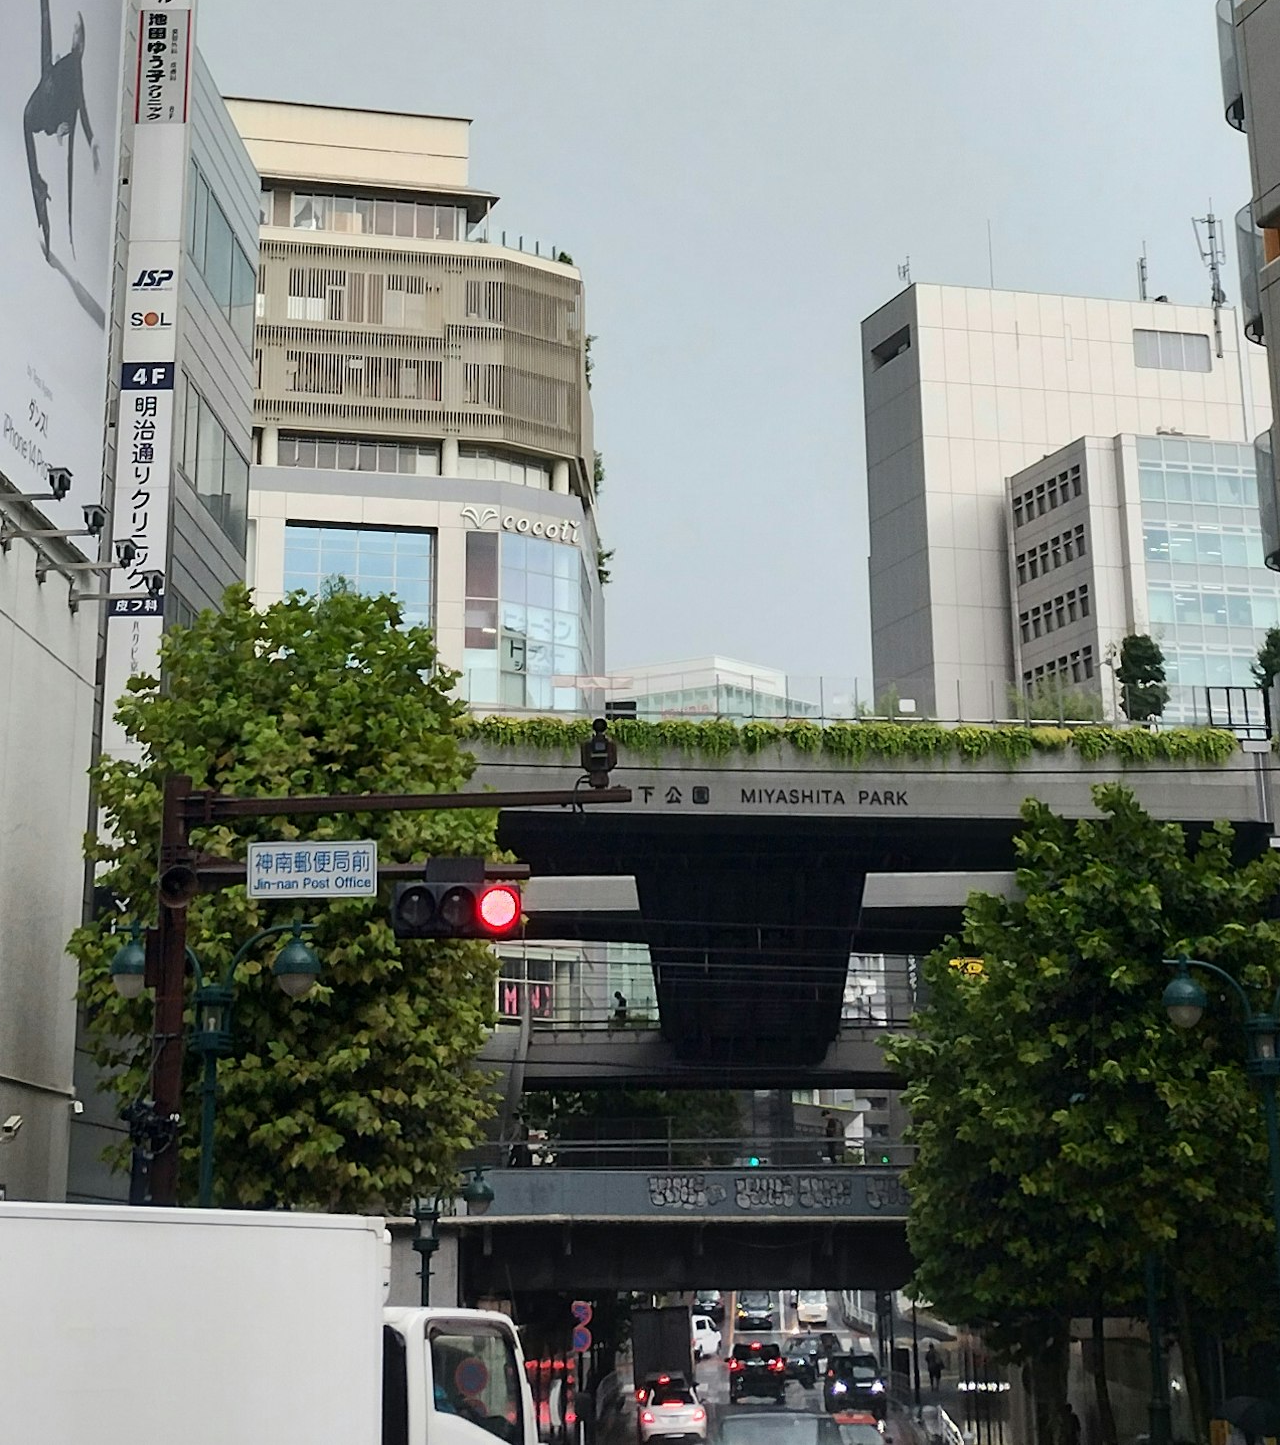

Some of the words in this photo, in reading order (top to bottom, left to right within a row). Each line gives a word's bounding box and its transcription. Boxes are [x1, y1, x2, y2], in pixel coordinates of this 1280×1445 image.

[131, 269, 174, 287] JSP
[502, 515, 581, 543] cocoti
[612, 785, 709, 805] 下公園
[740, 787, 846, 806] MIYASHITA
[857, 790, 909, 806] PARK
[255, 850, 370, 874] 神南郵便局前
[253, 877, 299, 891] Jin-nan
[302, 876, 330, 890] Post
[334, 875, 372, 889] Office
